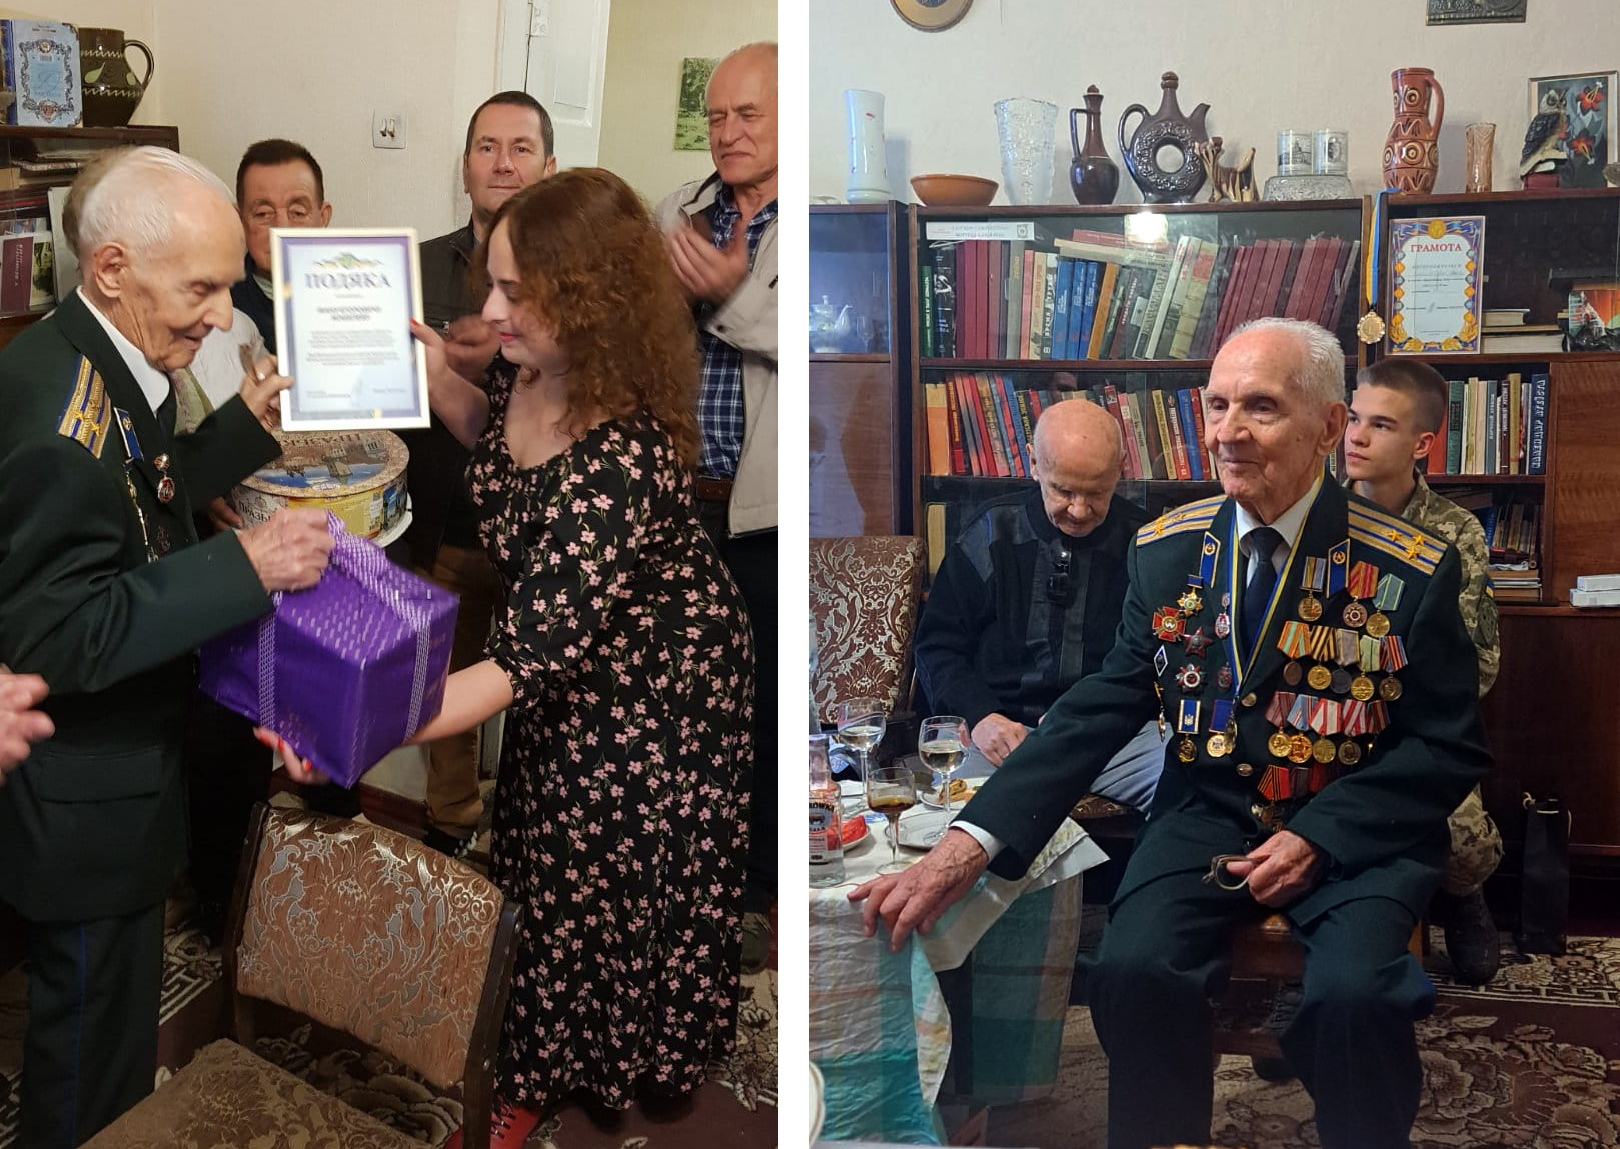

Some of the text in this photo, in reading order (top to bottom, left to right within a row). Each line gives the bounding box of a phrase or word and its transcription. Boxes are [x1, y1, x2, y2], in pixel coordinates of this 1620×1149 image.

[1410, 243, 1462, 253] ГРАМОТА
[304, 272, 392, 291] ПОДЯКА
[283, 433, 360, 447] ПРАЗЬК
[239, 502, 271, 523] ПРАЗЬ
